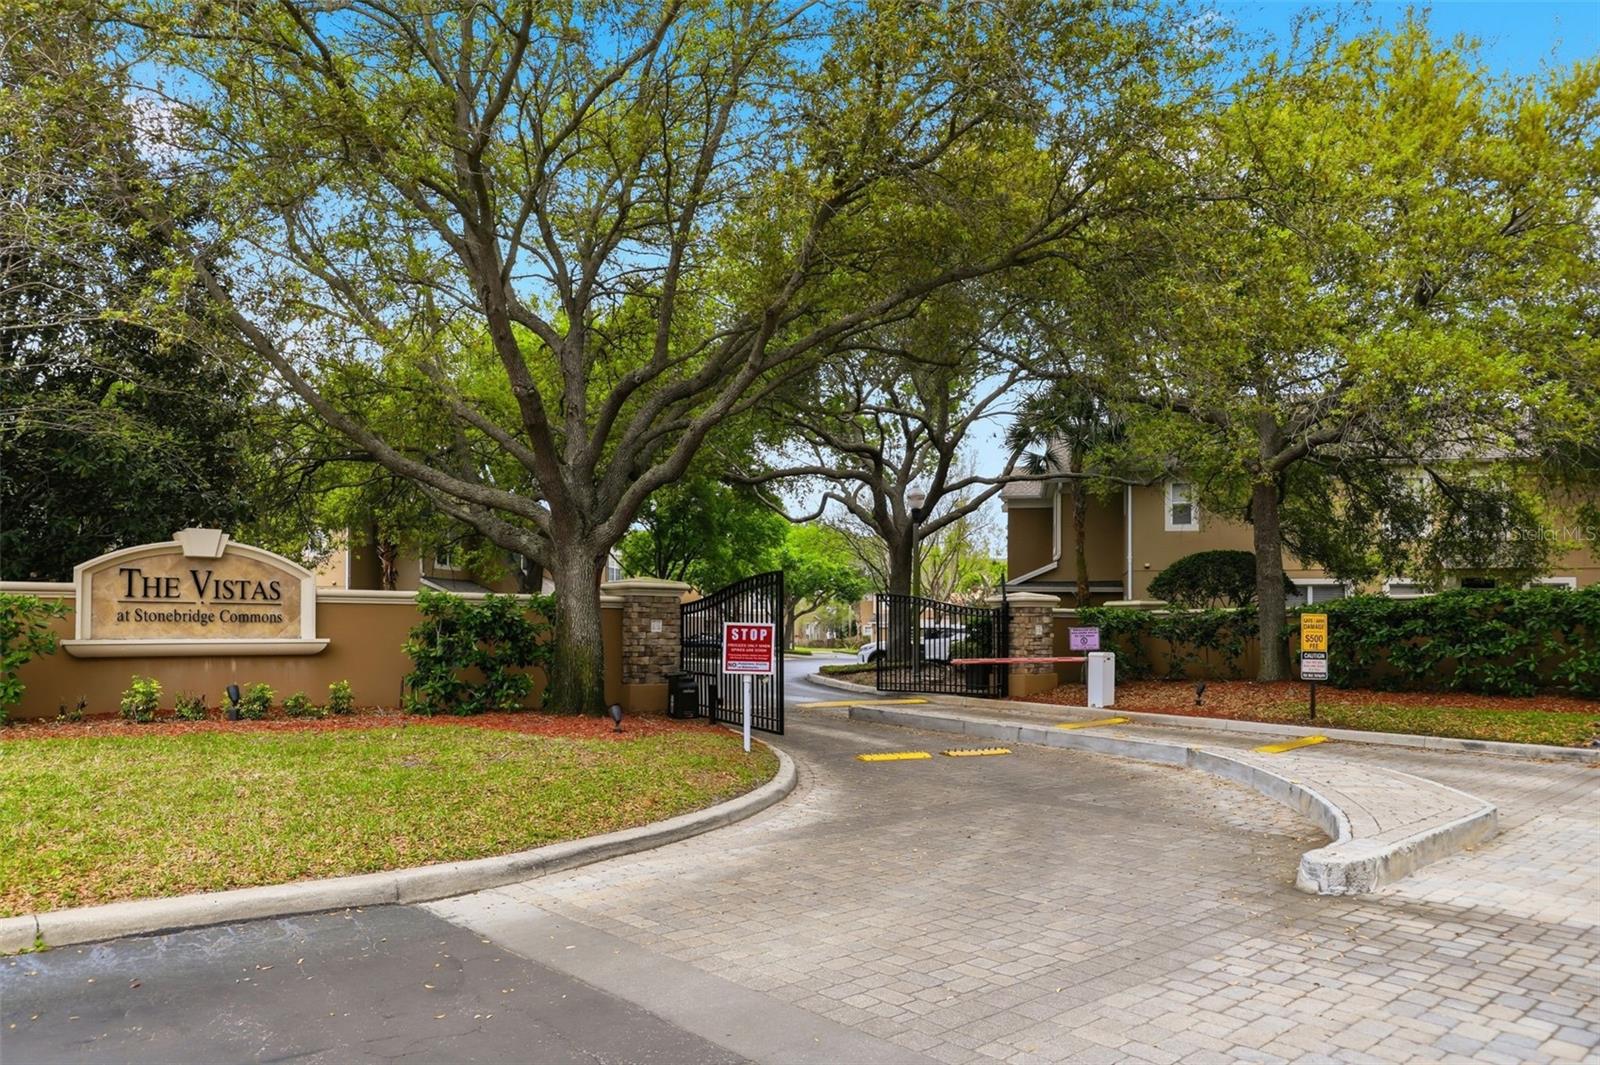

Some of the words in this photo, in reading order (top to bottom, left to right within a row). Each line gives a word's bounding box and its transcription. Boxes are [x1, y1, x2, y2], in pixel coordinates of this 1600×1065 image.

[117, 609, 130, 622] at
[134, 608, 215, 626] Stonebridge
[219, 609, 283, 624] Commons
[731, 628, 768, 640] STOP
[1305, 634, 1324, 642] $500
